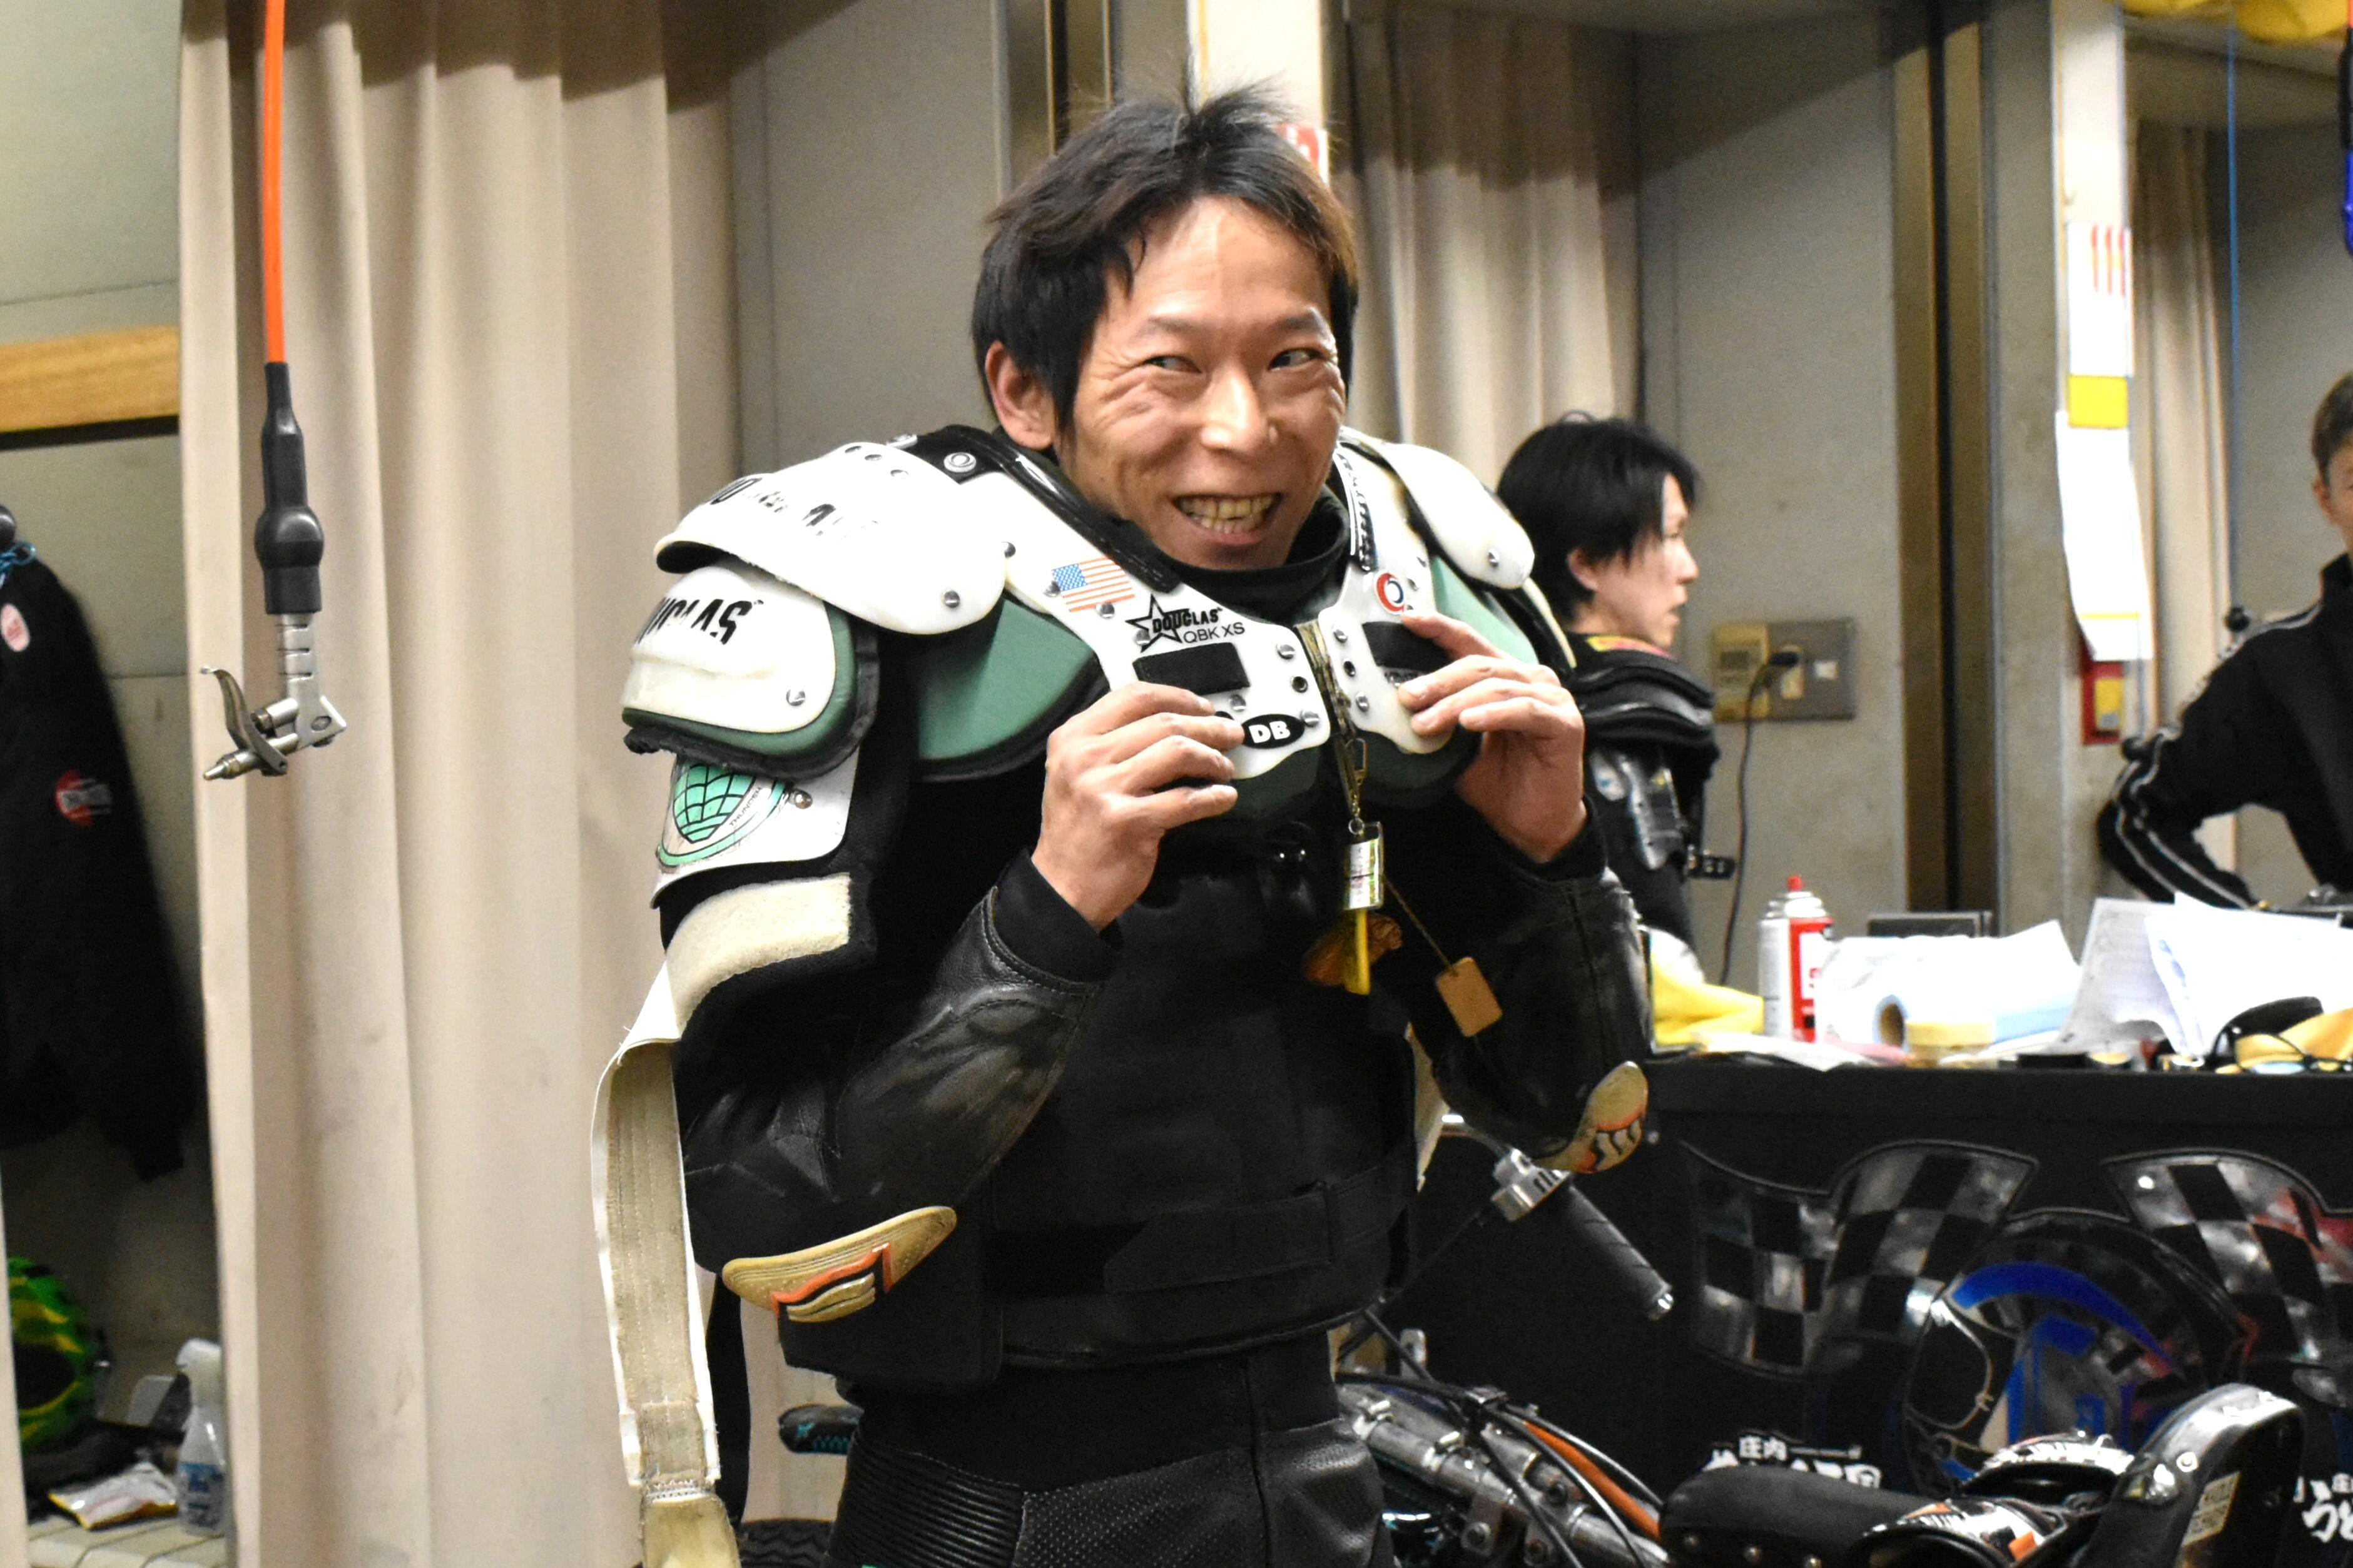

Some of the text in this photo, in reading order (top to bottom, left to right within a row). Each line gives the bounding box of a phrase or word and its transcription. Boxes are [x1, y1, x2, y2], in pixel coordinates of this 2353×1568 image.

[1183, 622, 1246, 644] QBK XS
[1248, 721, 1291, 744] DB
